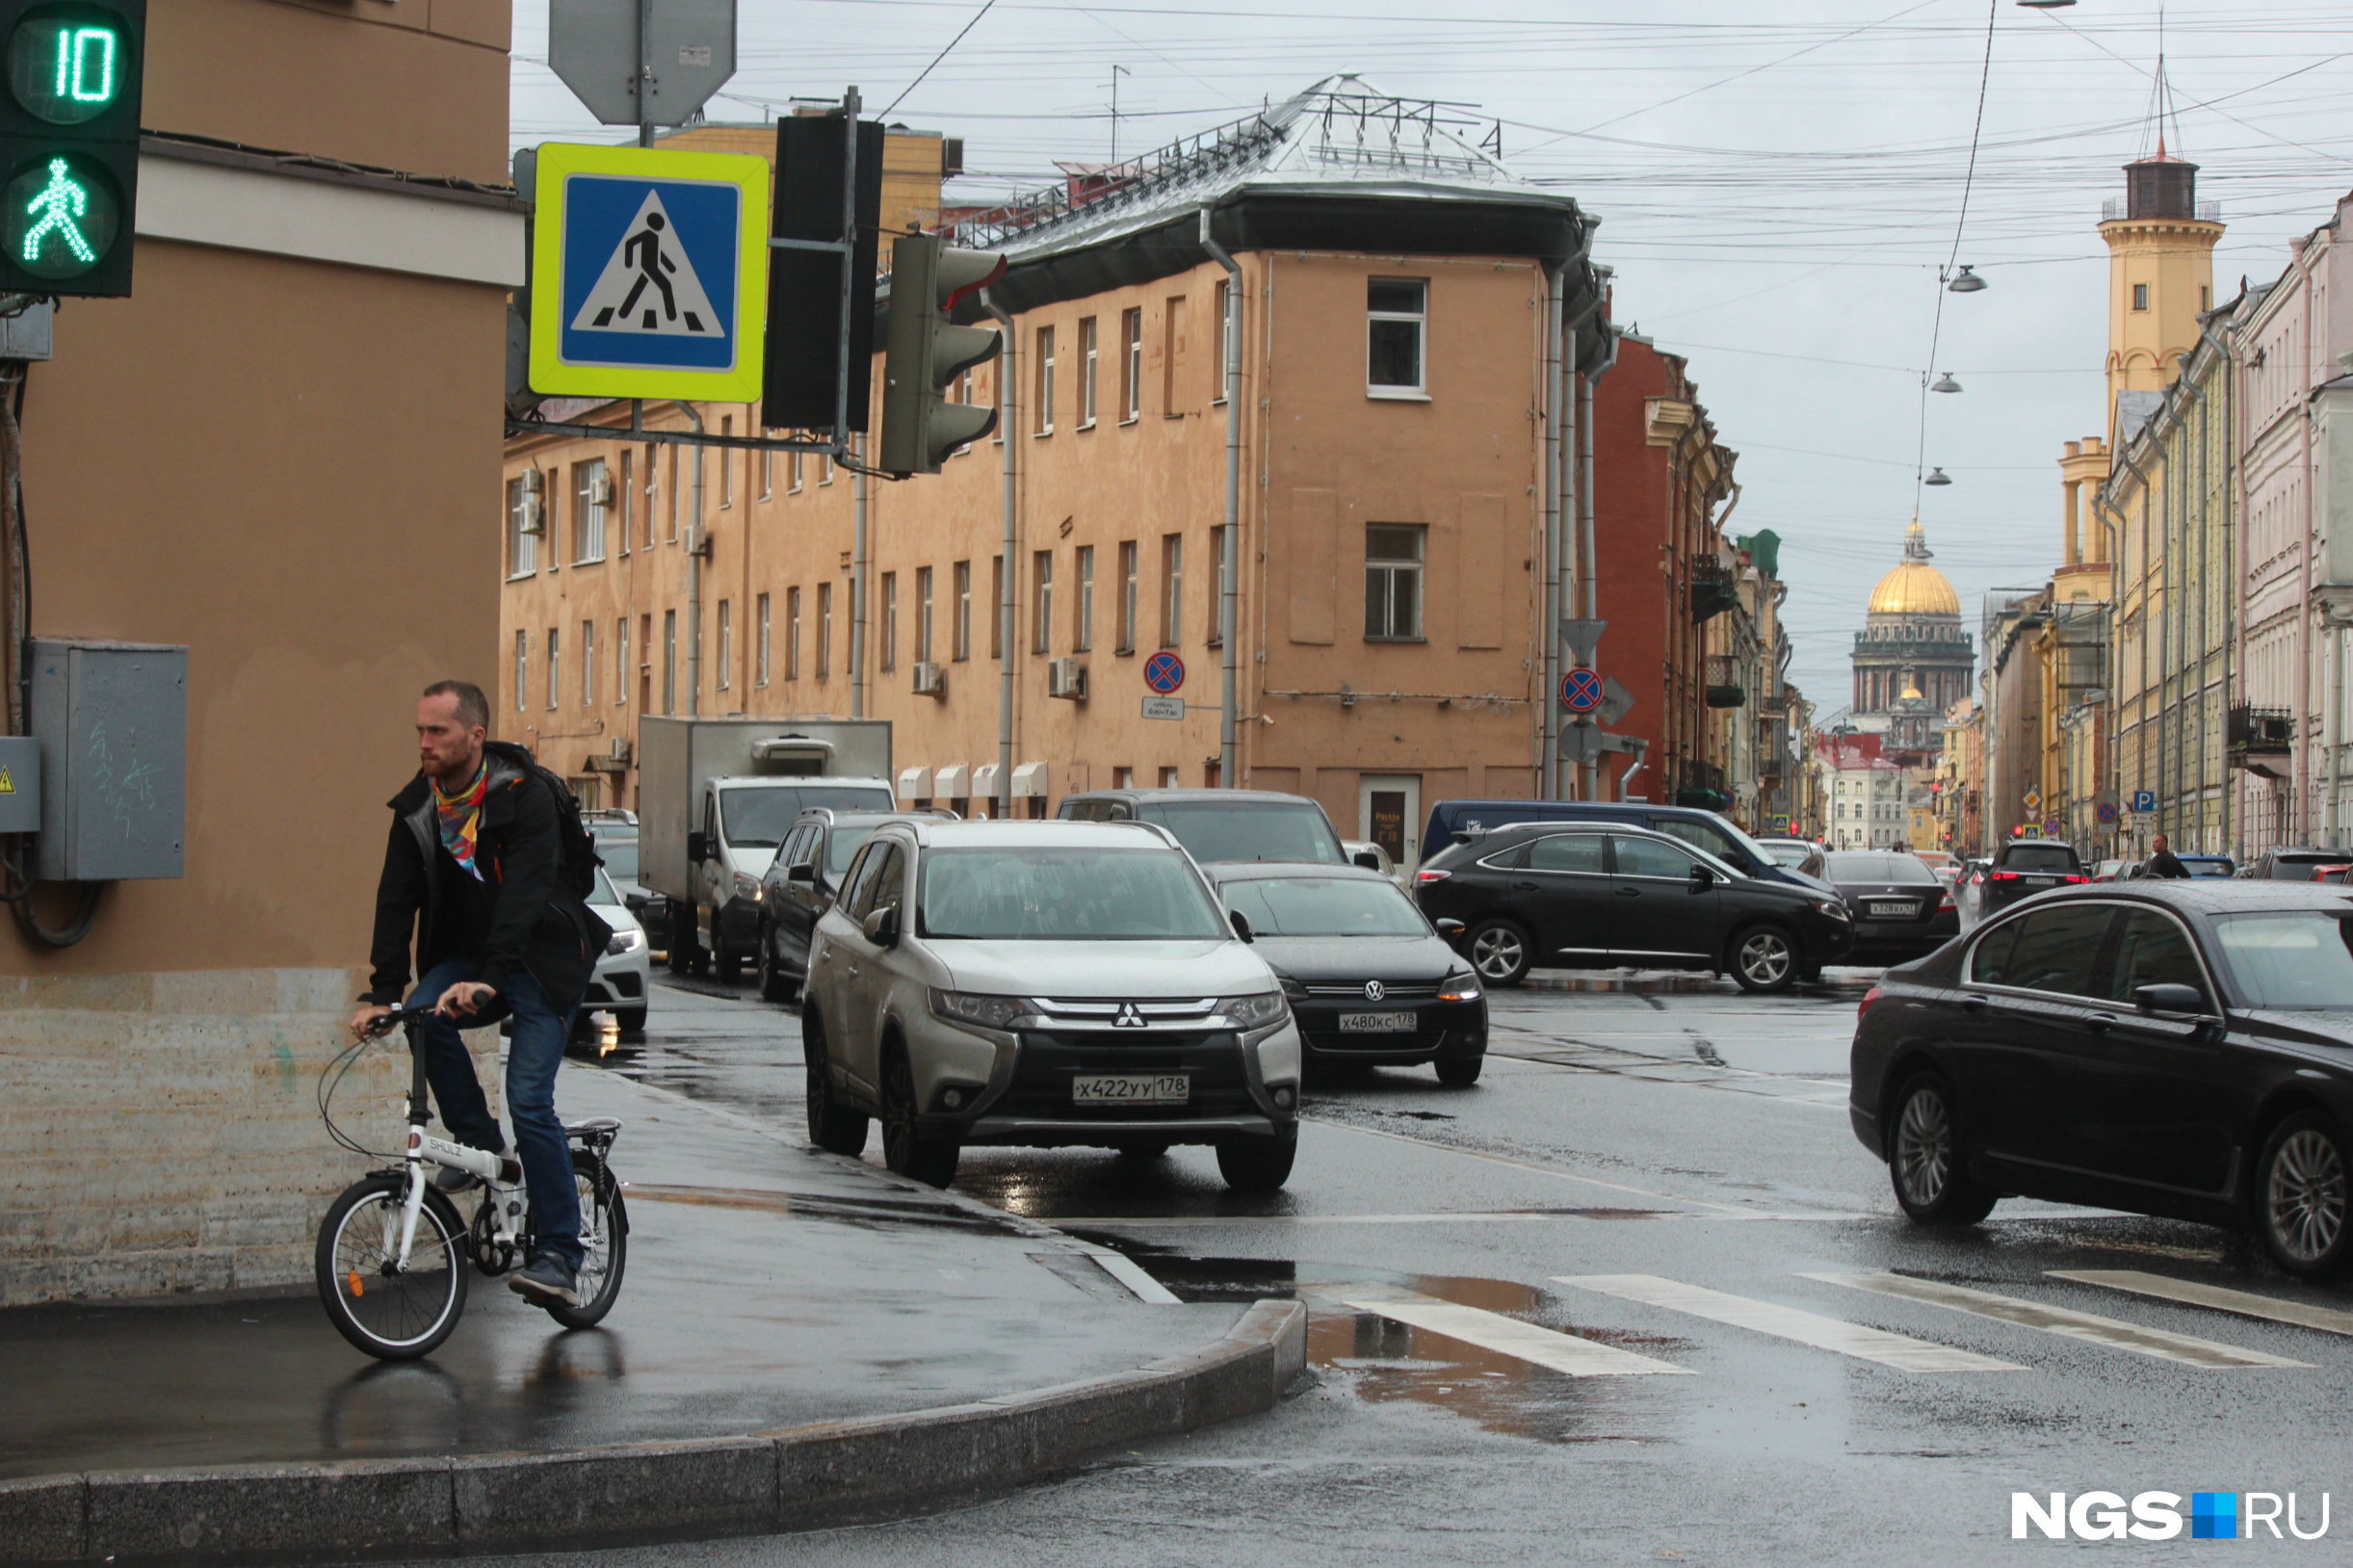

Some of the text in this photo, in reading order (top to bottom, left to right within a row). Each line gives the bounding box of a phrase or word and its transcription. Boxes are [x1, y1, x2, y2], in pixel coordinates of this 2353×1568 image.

[57, 28, 114, 101] 10
[1395, 1013, 1415, 1024] 178
[1157, 1078, 1185, 1091] 178
[430, 1138, 462, 1157] SHULZ
